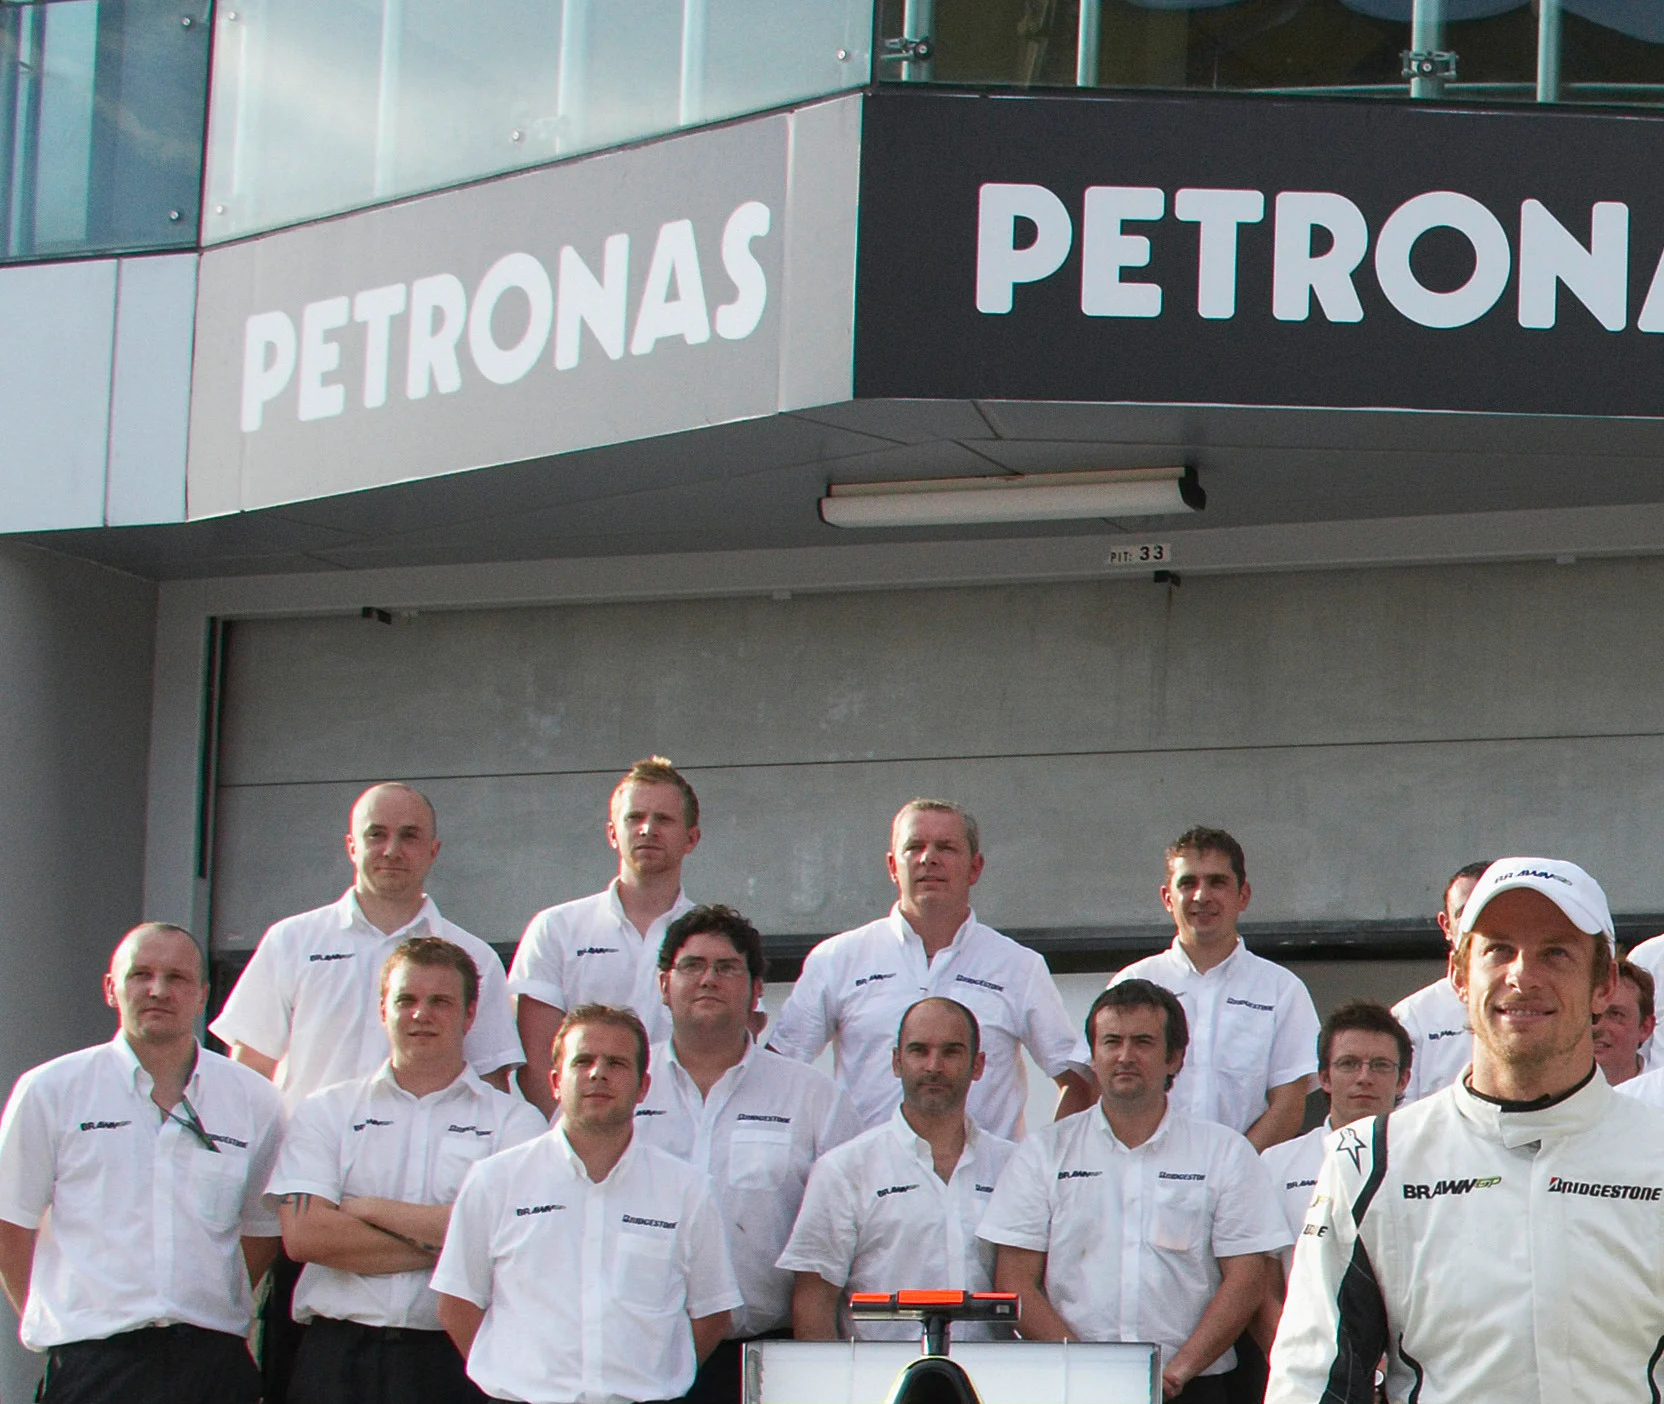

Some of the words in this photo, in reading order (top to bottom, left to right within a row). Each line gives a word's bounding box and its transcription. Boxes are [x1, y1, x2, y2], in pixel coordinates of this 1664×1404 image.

[240, 201, 770, 432] PETRONAS
[1110, 552, 1132, 562] PIT:
[1140, 545, 1164, 560] 33
[1548, 1177, 1662, 1201] BRIDGESTONE
